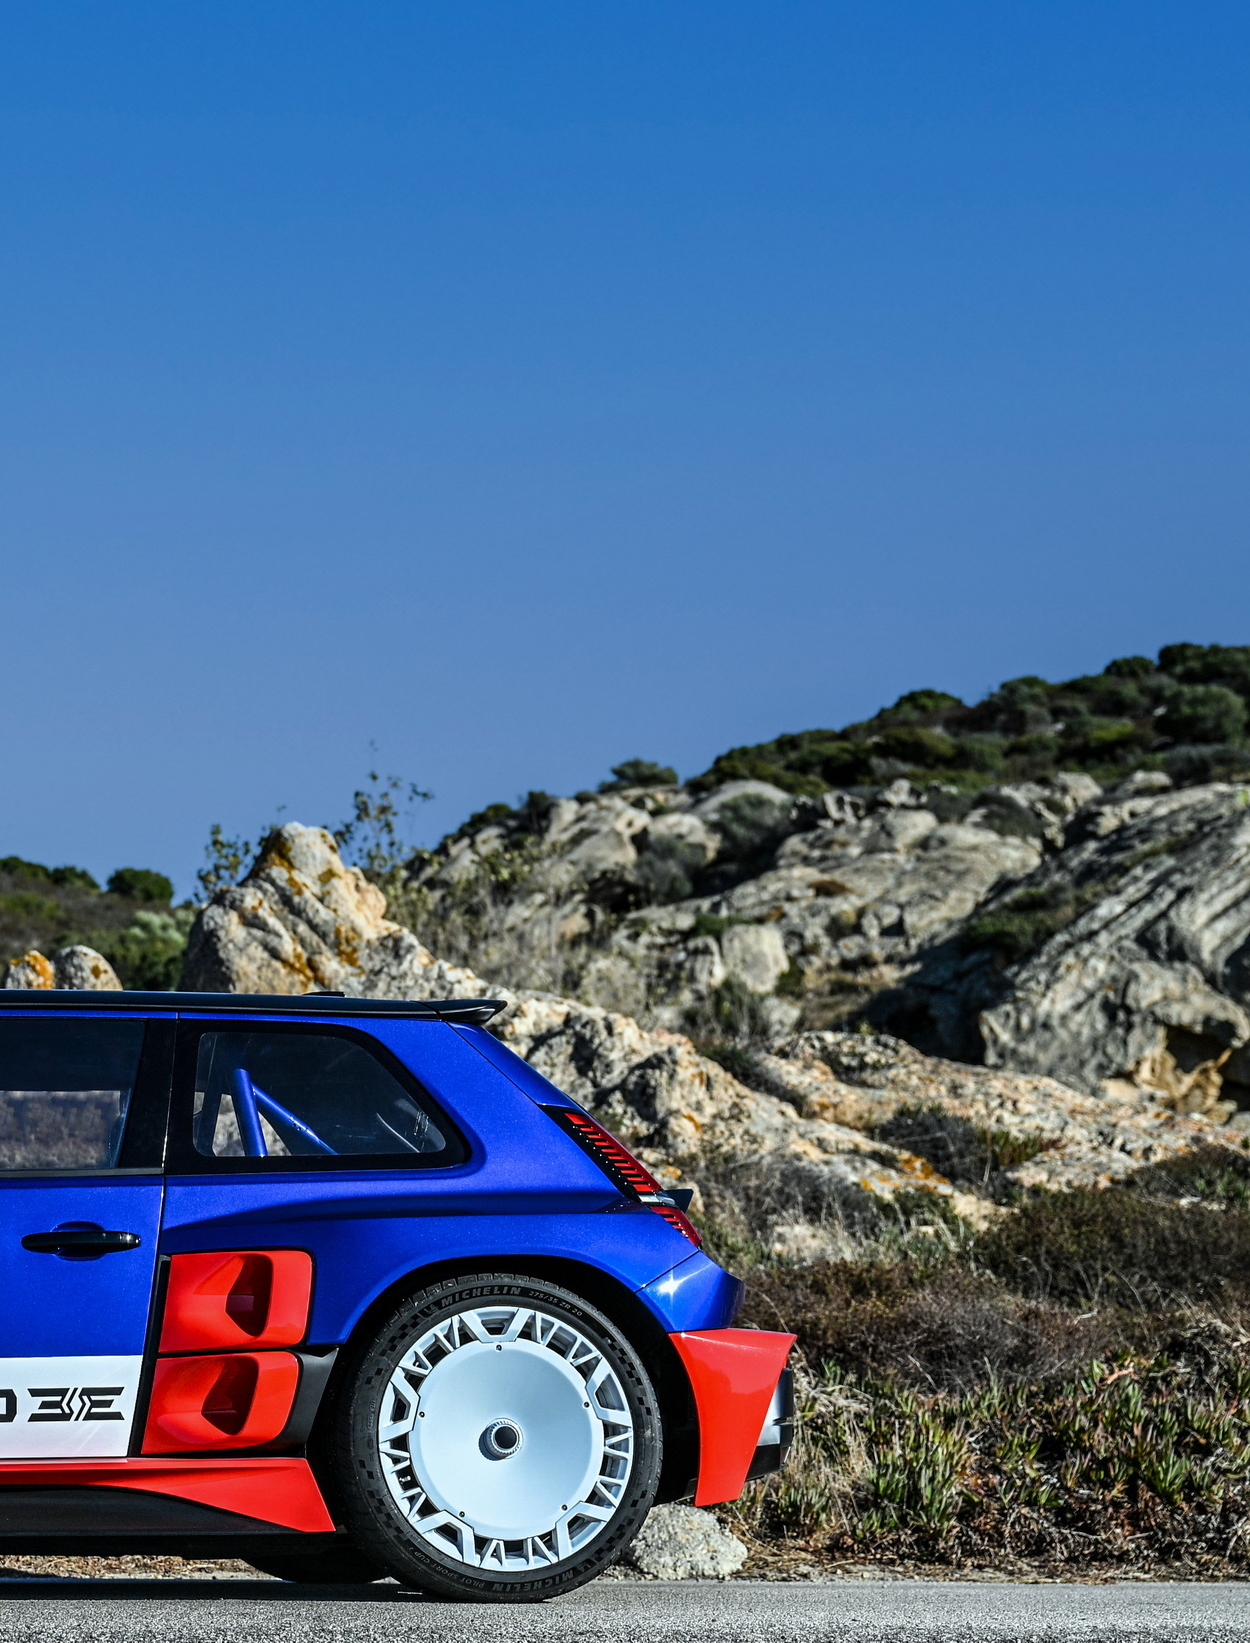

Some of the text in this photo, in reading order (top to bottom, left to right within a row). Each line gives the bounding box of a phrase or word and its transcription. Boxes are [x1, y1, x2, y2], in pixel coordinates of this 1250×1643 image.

[441, 1286, 522, 1307] MICHELIN
[528, 1290, 583, 1317] 275/35 ZR 20
[414, 1551, 431, 1564] CUP
[430, 1563, 458, 1579] SPORT
[460, 1576, 485, 1587] PILOT
[491, 1569, 574, 1592] MICHELIN
